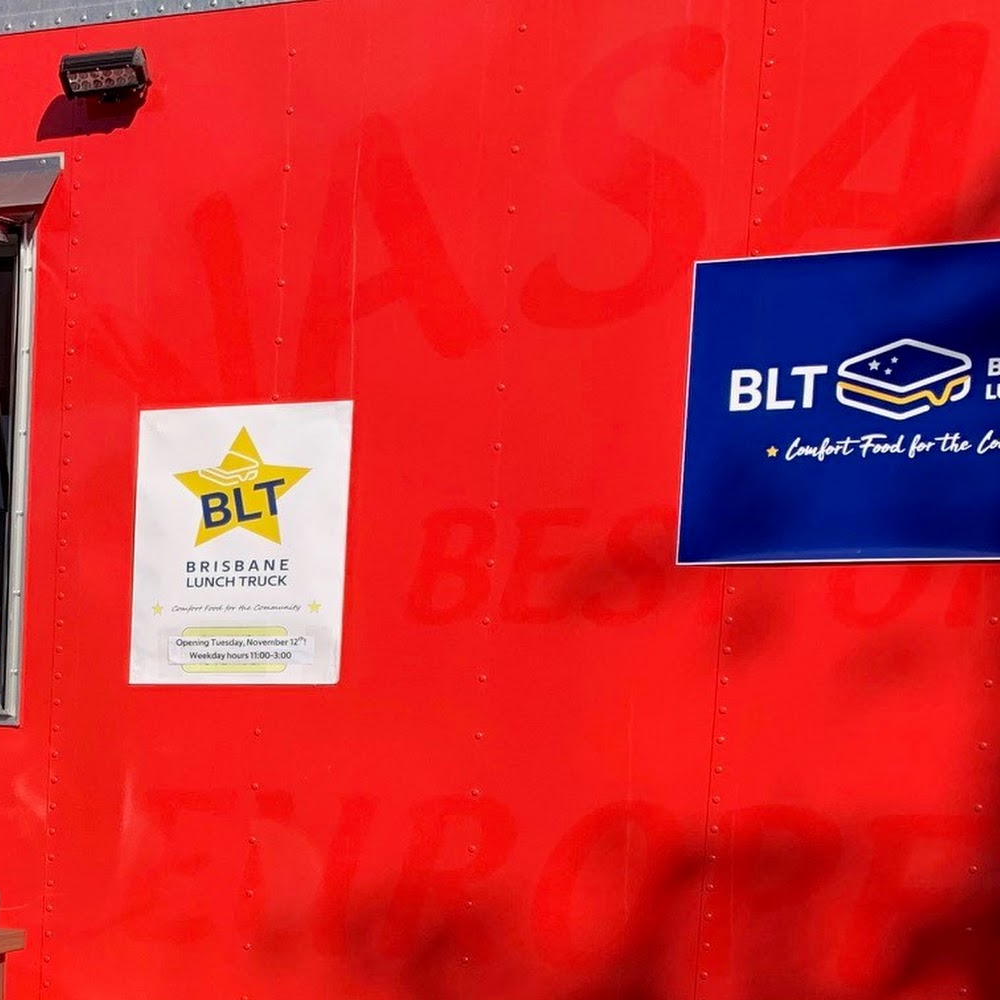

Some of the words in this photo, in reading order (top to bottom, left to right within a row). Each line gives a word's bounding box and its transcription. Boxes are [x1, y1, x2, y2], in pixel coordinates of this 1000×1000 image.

[728, 364, 828, 412] BLT
[785, 436, 861, 462] Comfort
[859, 432, 906, 458] Food
[907, 433, 936, 458] for
[934, 432, 972, 453] the
[200, 478, 286, 529] BLT
[186, 558, 289, 574] BRISBANE
[186, 576, 235, 589] LUNCH
[239, 574, 288, 588] TRUCK
[171, 603, 202, 613] Comfort
[204, 604, 223, 612] Food
[224, 604, 237, 613] for
[253, 603, 301, 612] Community
[175, 638, 210, 648] Opening
[211, 637, 246, 648] Tuesday,
[246, 637, 288, 646] November
[189, 652, 225, 661] Weekday
[226, 651, 249, 660] hours
[250, 651, 292, 660] 11:00-3:00
